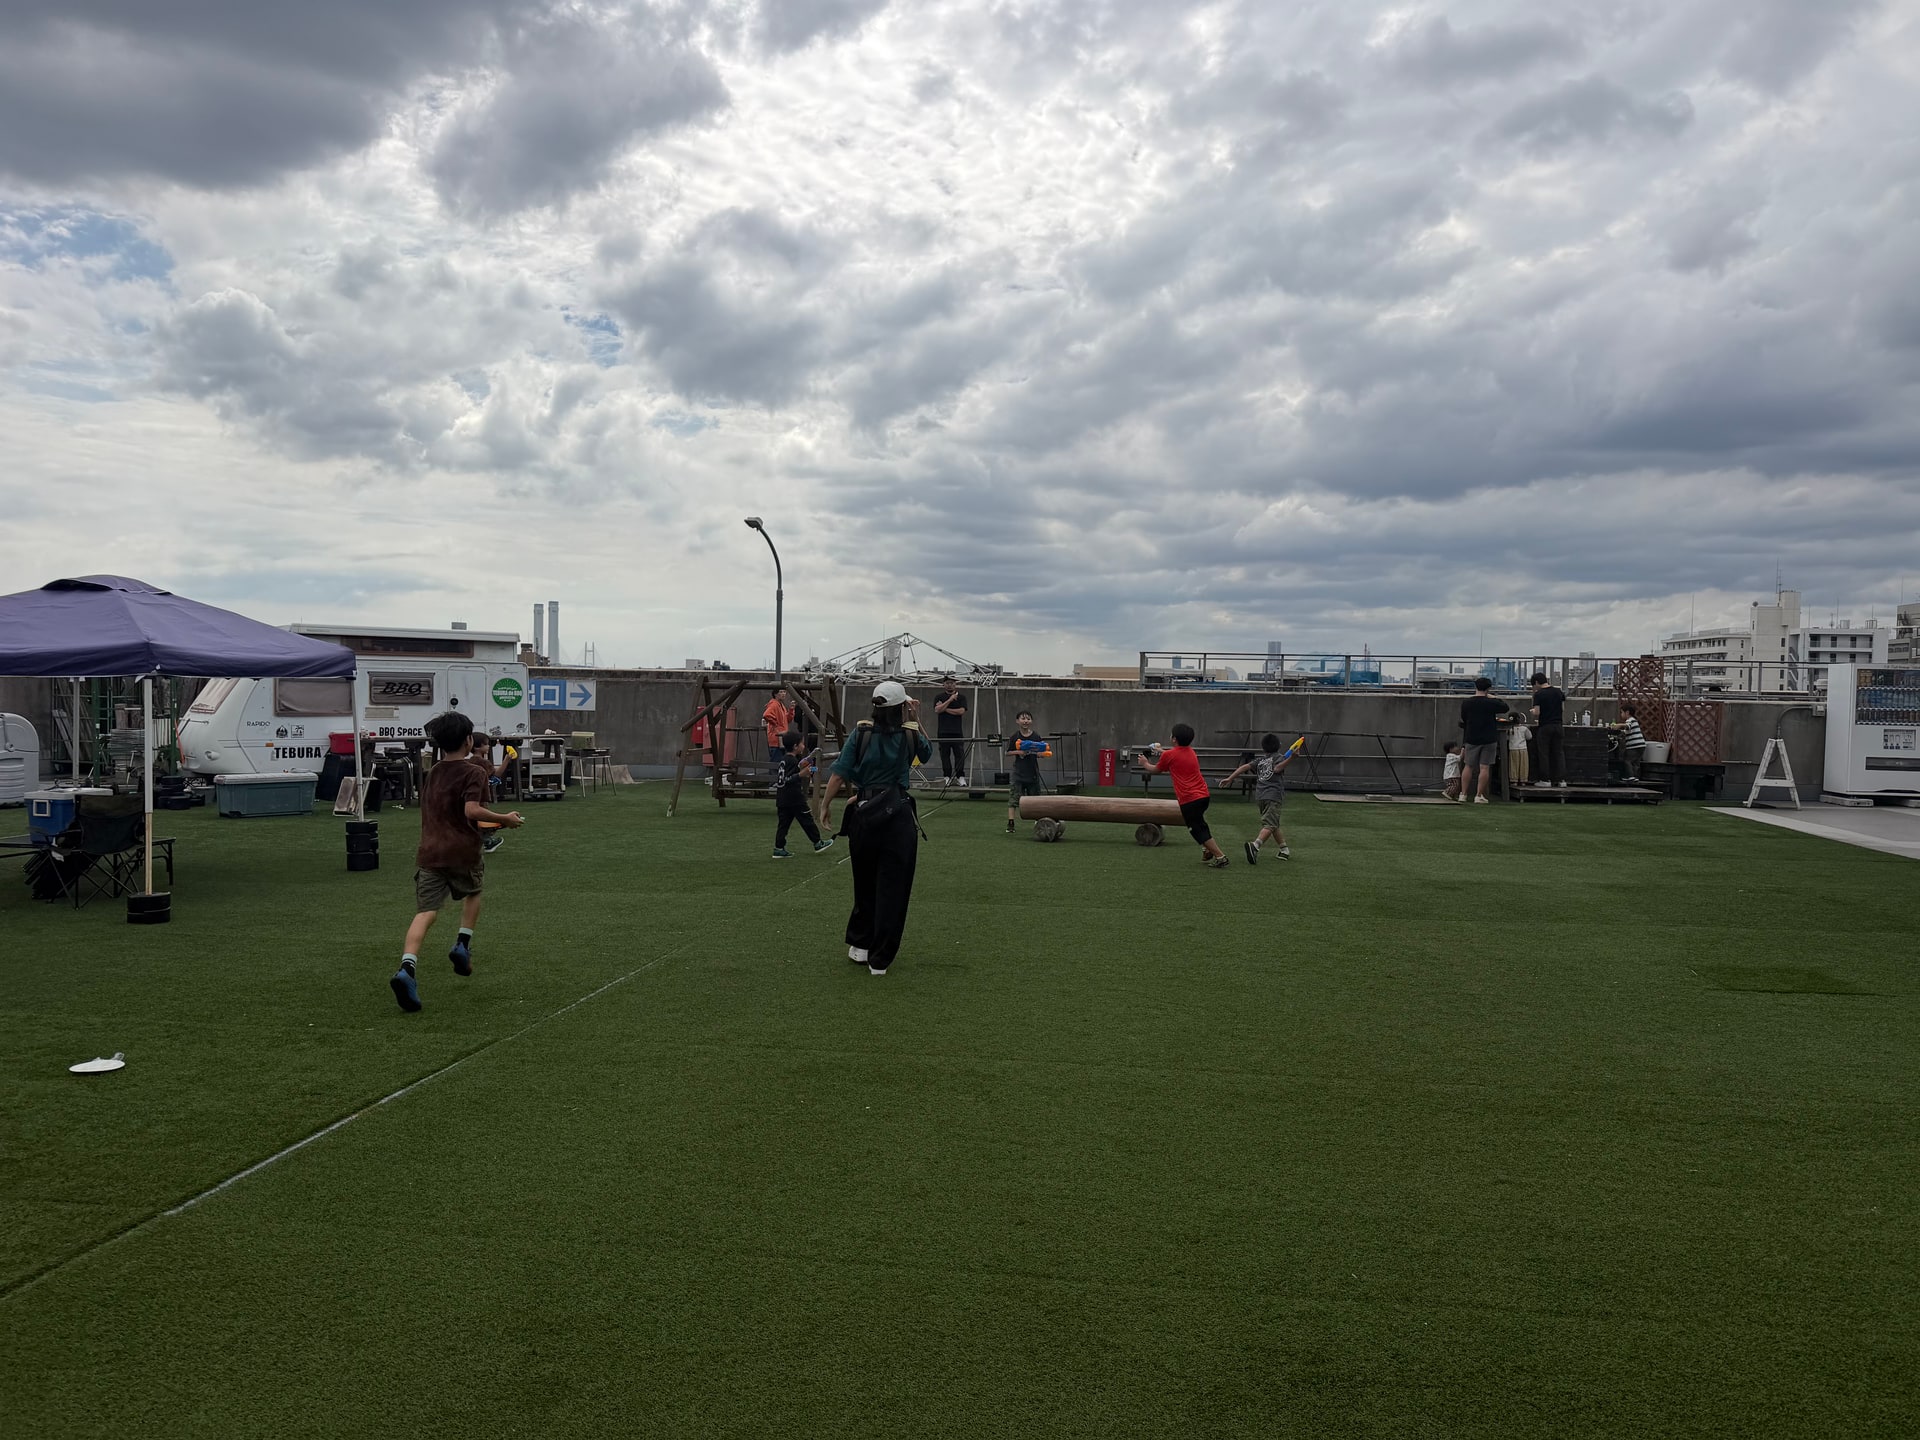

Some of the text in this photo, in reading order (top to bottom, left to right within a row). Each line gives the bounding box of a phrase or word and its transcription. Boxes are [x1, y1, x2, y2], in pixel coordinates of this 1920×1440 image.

[381, 682, 422, 696] BBQ
[379, 727, 423, 738] BBQ SPACE
[274, 747, 321, 758] TEBURA
